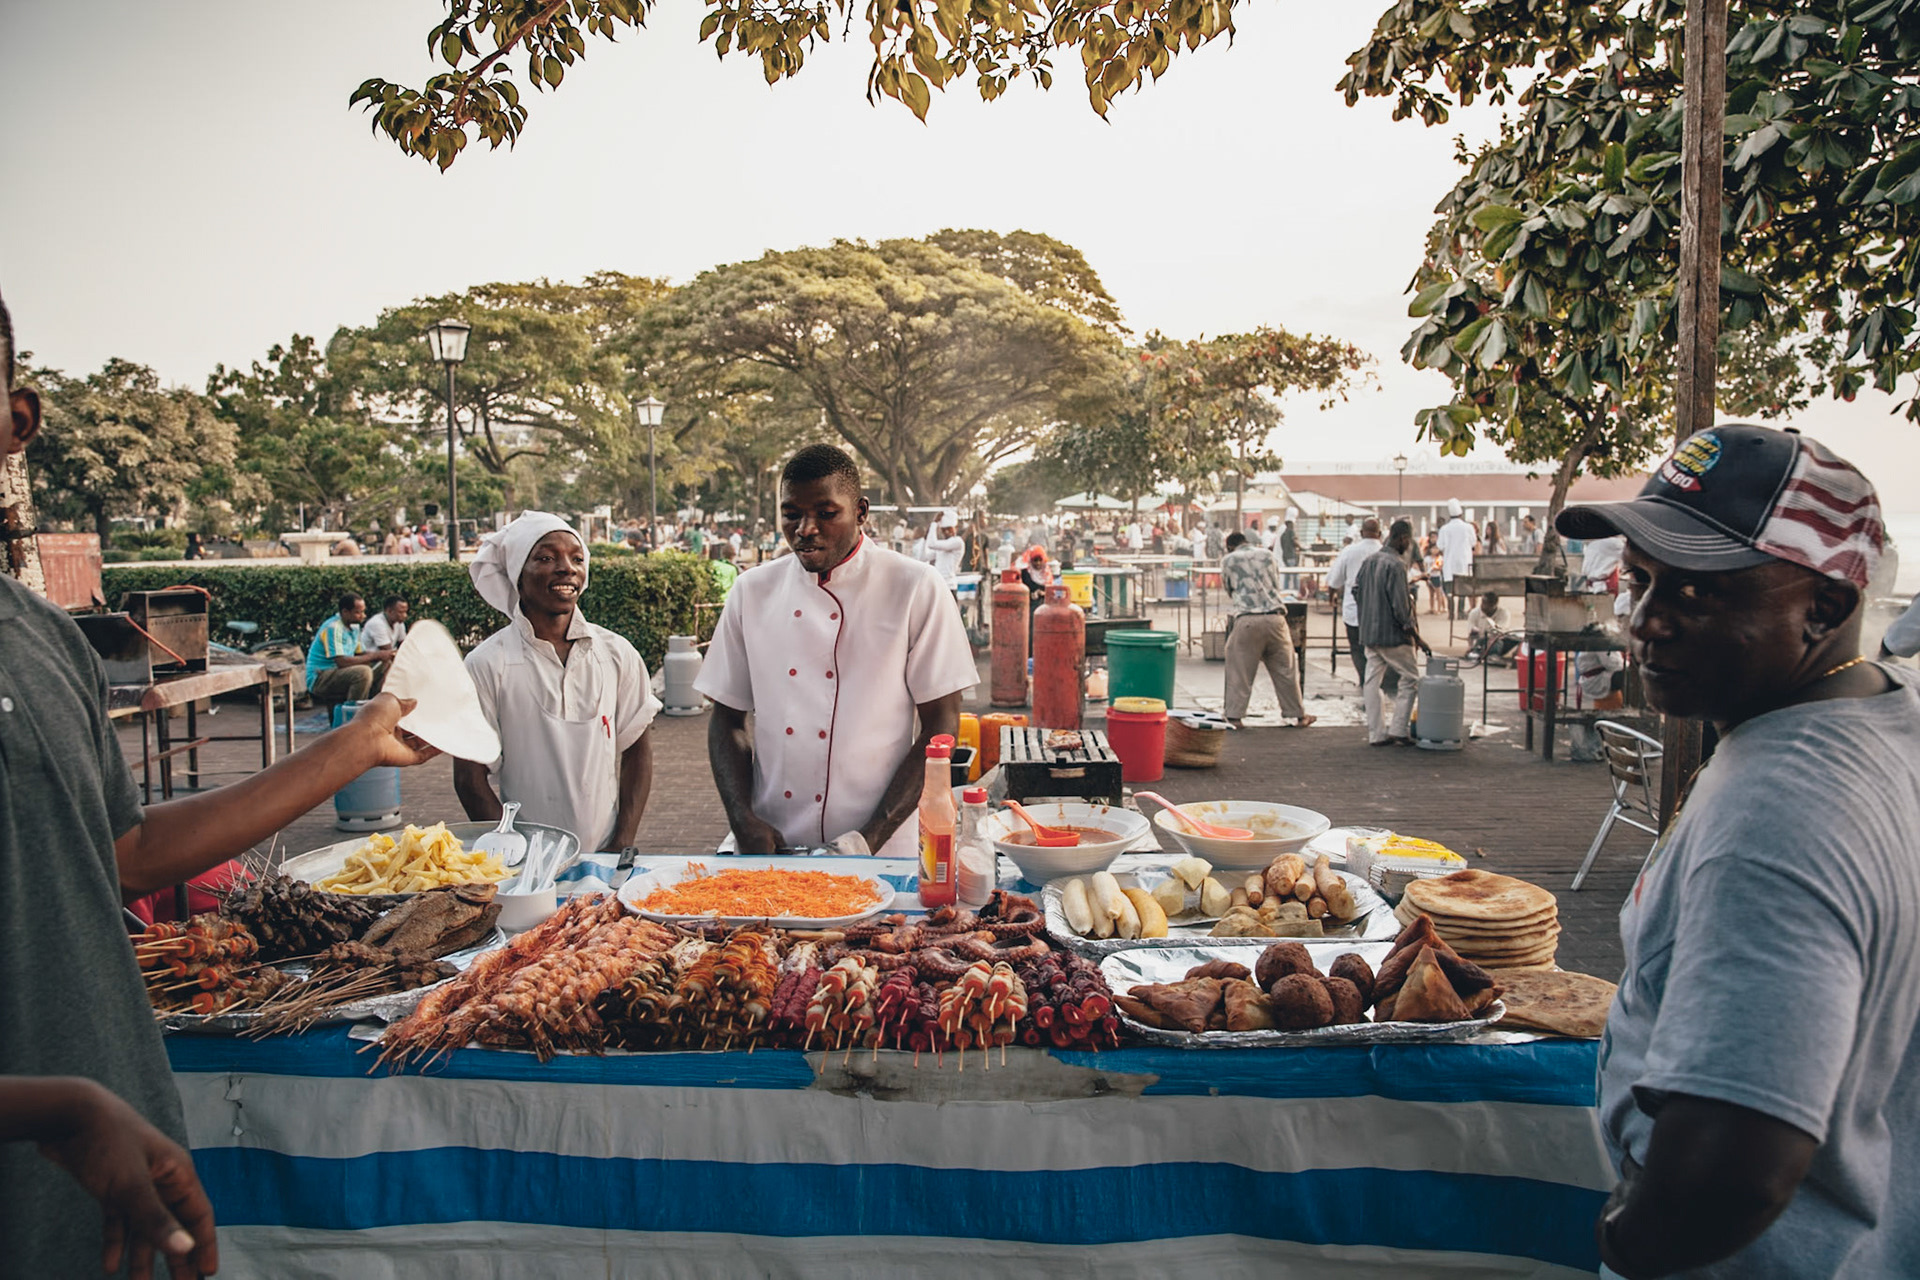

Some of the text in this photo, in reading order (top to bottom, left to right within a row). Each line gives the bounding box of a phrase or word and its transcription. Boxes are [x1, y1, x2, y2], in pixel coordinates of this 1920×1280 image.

[1334, 462, 1517, 472] THE FLOING RESTAURANT
